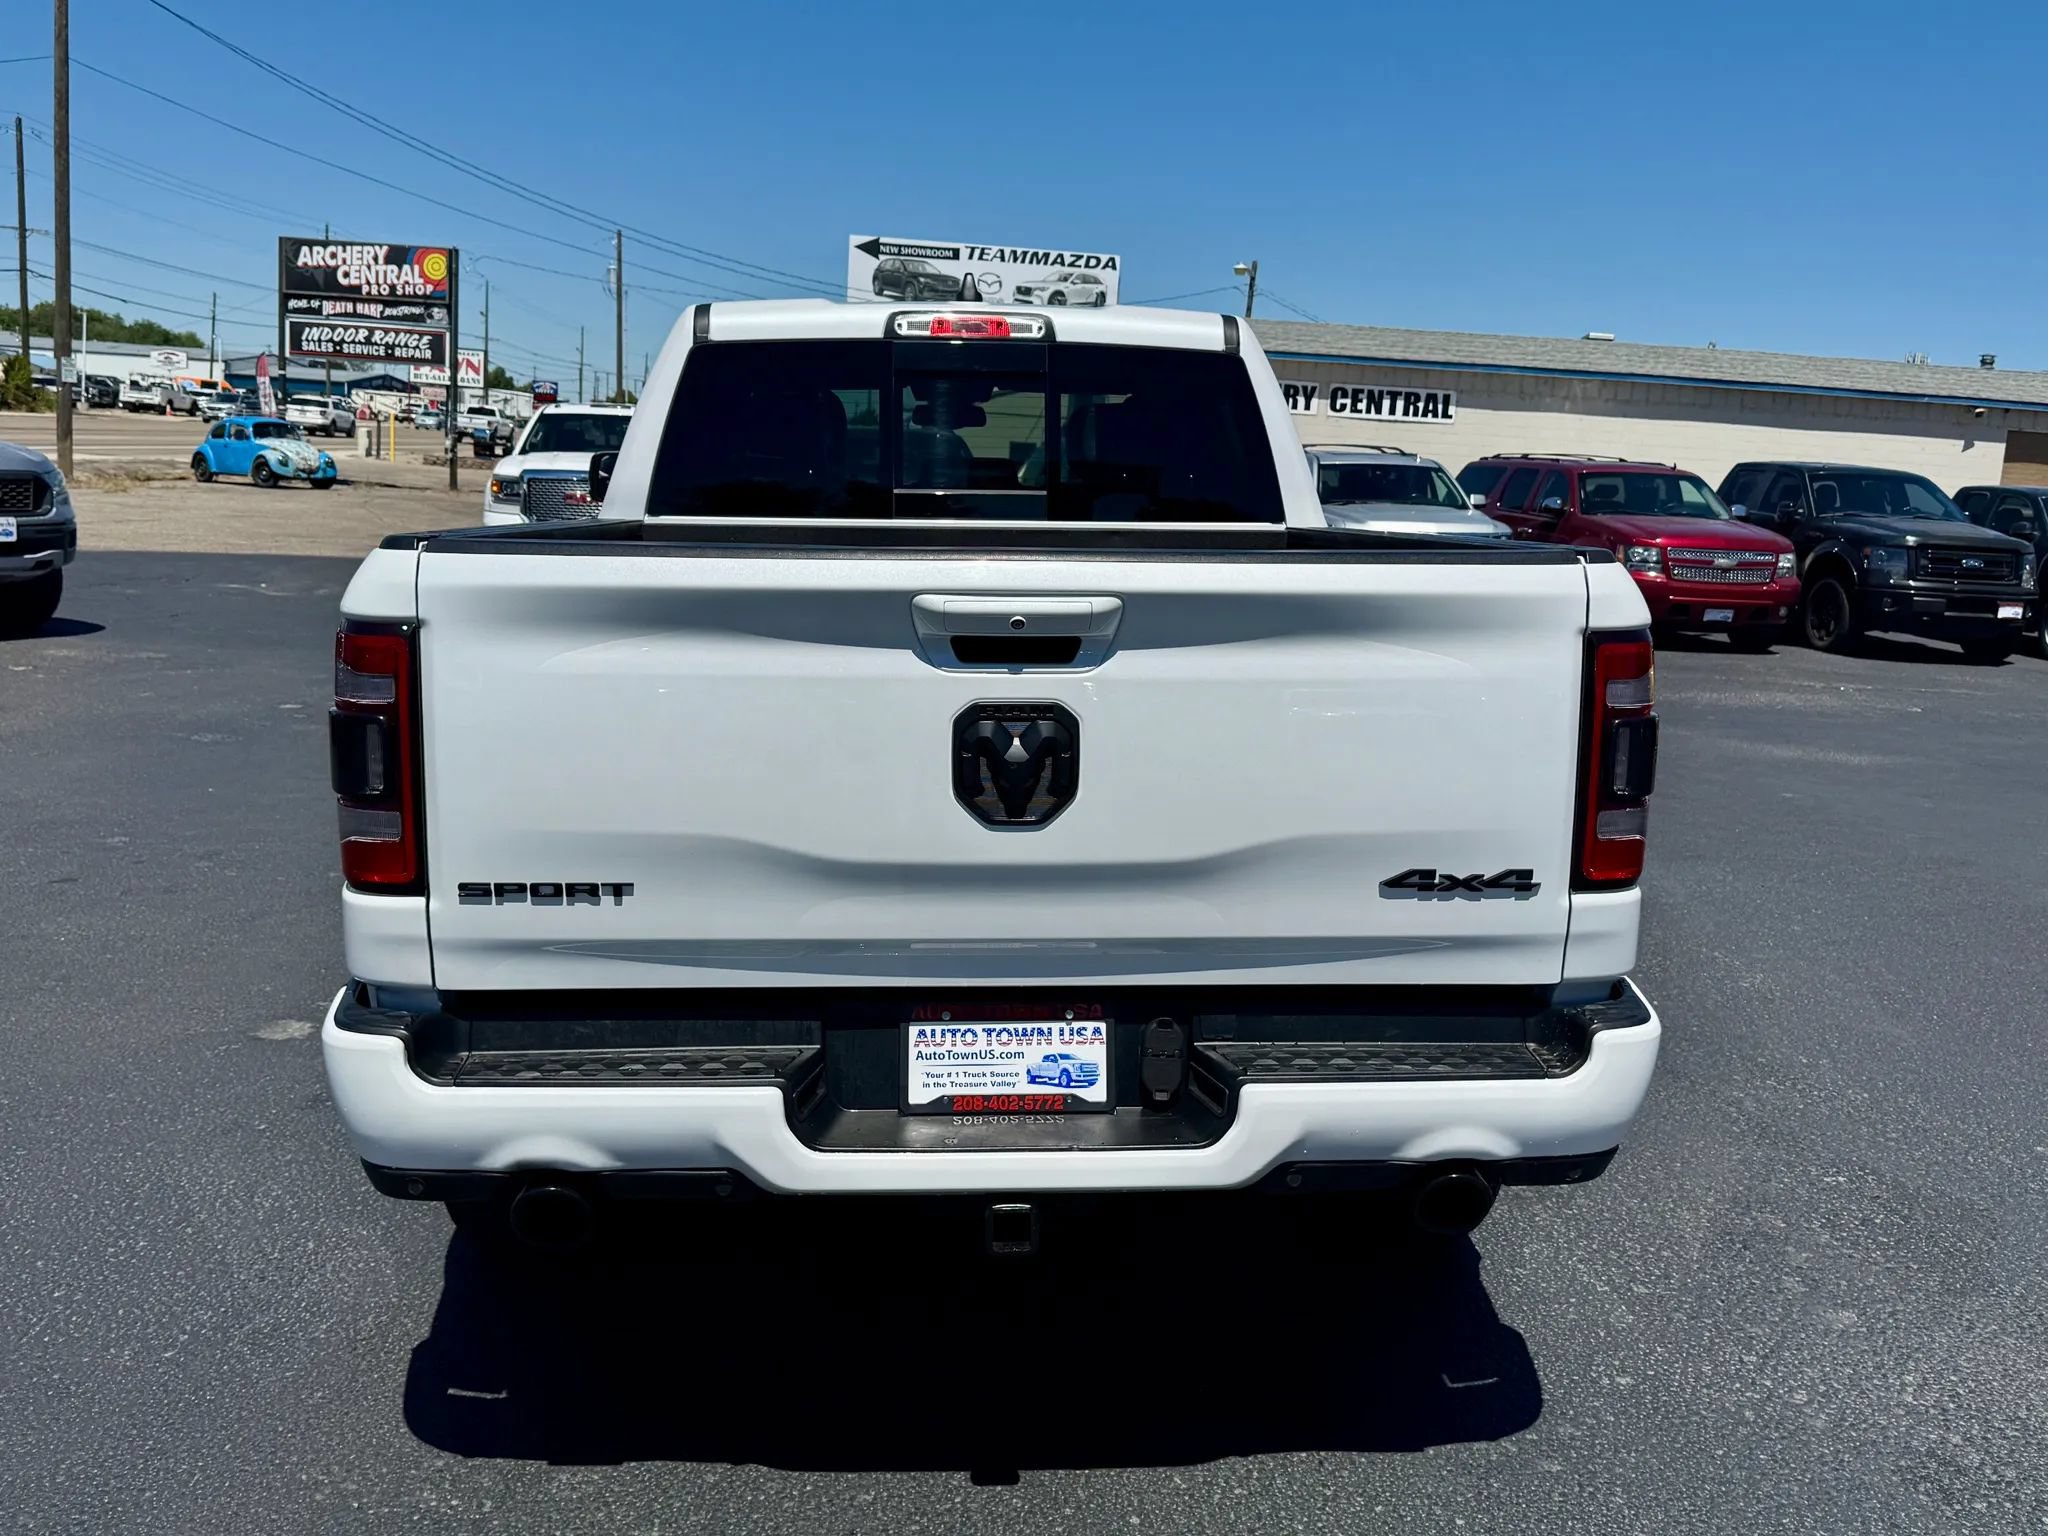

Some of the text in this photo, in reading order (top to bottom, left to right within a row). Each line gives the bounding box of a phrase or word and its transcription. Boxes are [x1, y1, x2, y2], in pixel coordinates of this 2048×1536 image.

[297, 245, 389, 267] ARCHERY
[880, 245, 953, 258] NEW SHOWROOM
[337, 264, 424, 286] CENTRAL
[361, 284, 434, 296] PRO SHOP
[322, 300, 353, 316] DEATH
[301, 327, 432, 349] INDOOR RANGE
[301, 341, 432, 360] SALES SERVICE REPAIR
[1329, 386, 1453, 419] CENTRAL
[458, 882, 635, 906] SPORT
[1379, 869, 1541, 901] 4x4
[914, 1026, 1106, 1048] AUTO TOWN USA
[915, 1049, 1025, 1061] AutoTownUS.com
[989, 1070, 1020, 1078] Source
[952, 1095, 1065, 1111] 208-402-5772
